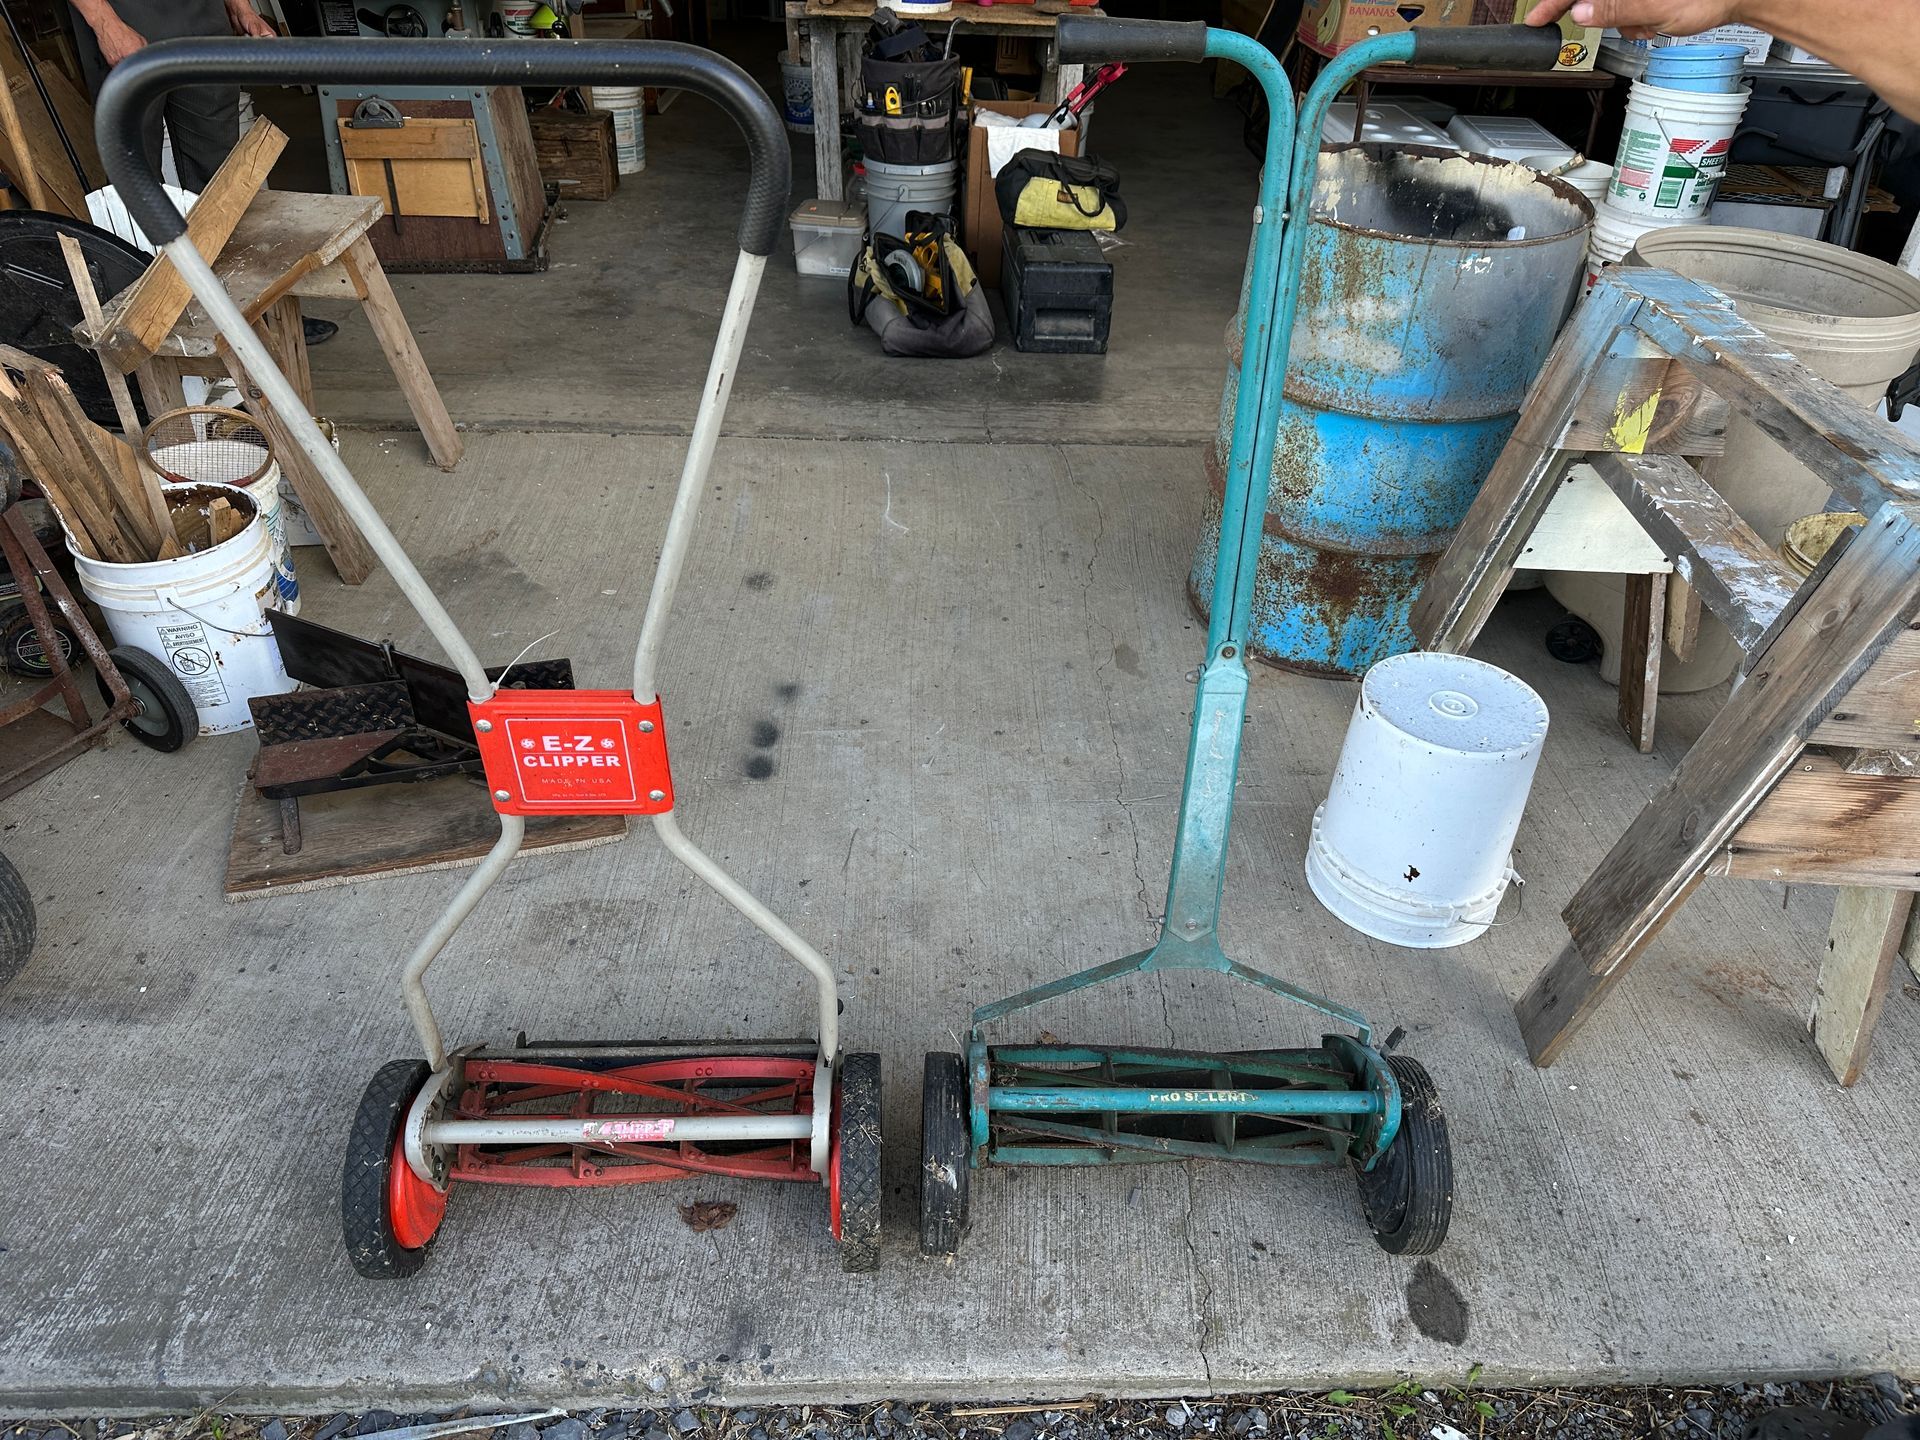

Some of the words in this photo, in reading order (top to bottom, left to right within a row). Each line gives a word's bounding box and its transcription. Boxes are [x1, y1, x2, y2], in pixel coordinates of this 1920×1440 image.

[1349, 7, 1395, 17] BANANAS
[166, 624, 198, 633] WARNING
[175, 632, 195, 640] AVISO
[541, 735, 595, 751] E-Z
[523, 755, 621, 767] CLIPPER
[1149, 1092, 1180, 1102] PRO
